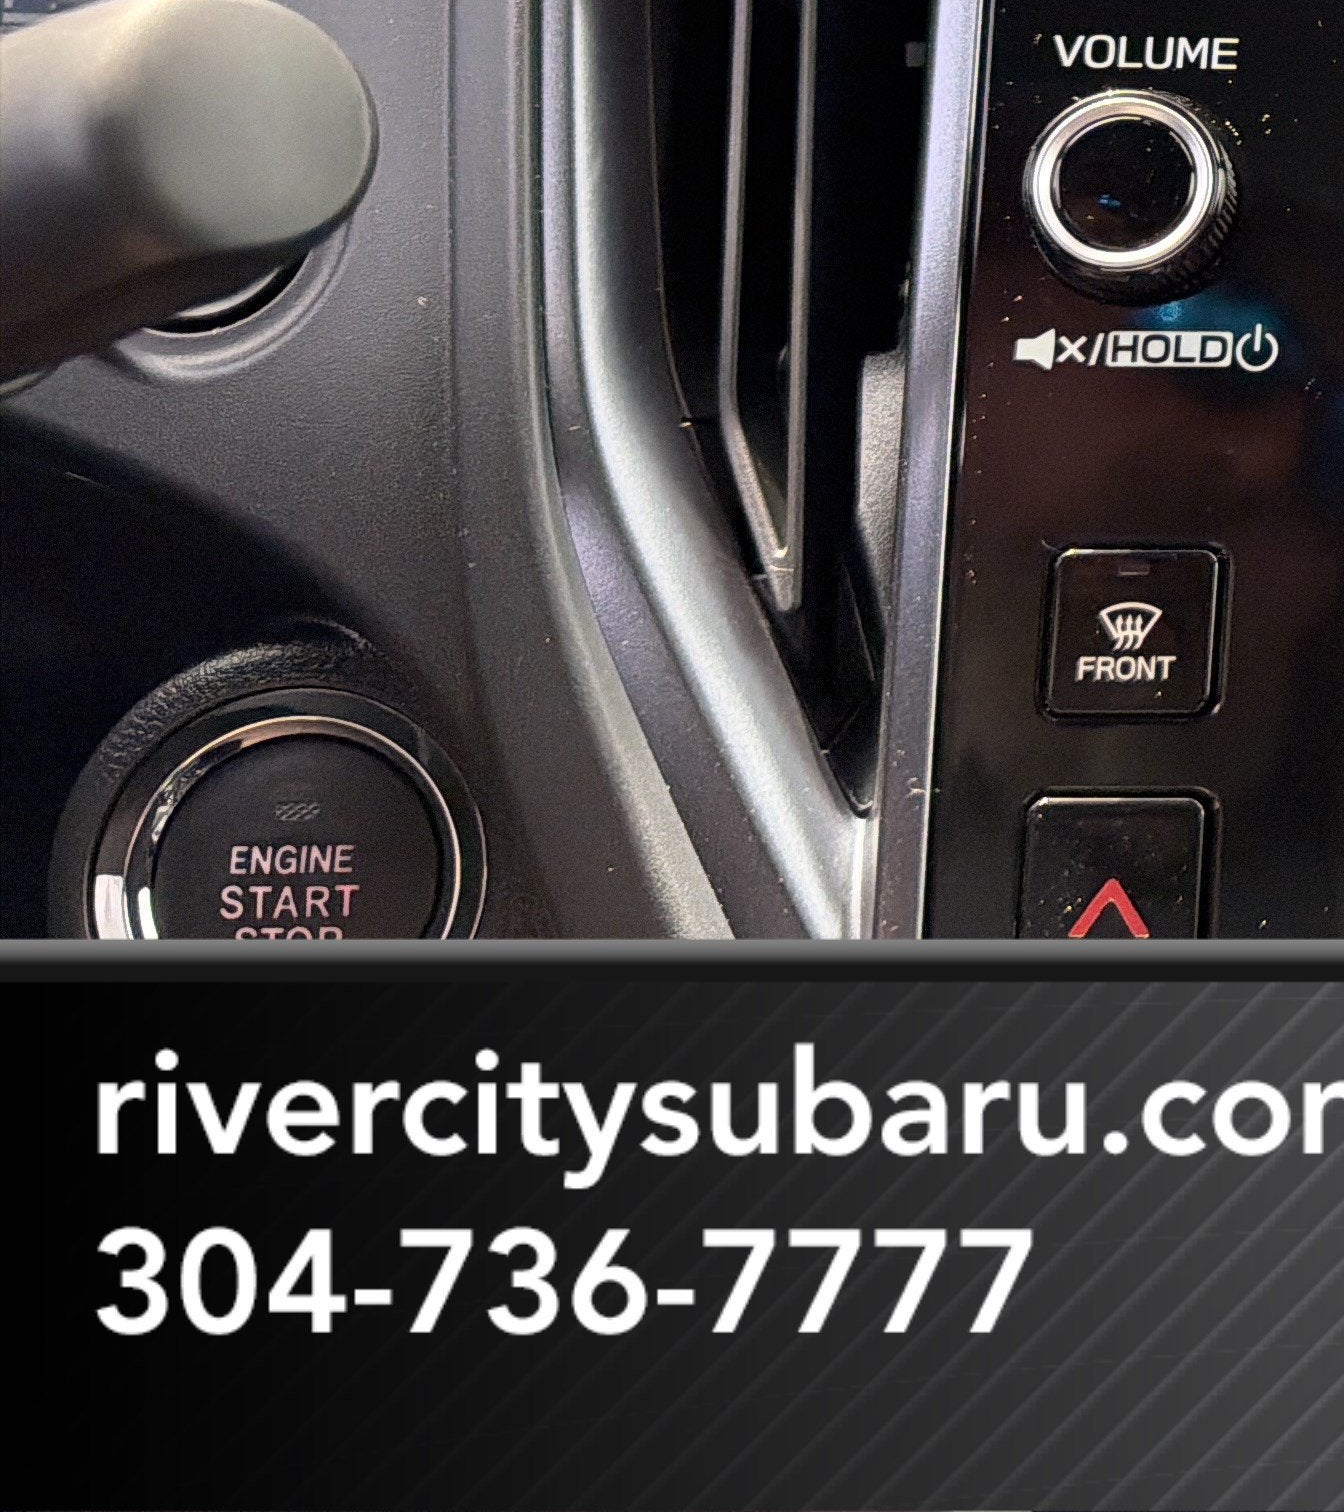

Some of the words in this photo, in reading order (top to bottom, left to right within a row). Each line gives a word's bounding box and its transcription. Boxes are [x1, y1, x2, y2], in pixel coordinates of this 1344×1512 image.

[1053, 34, 1240, 70] VOLUME
[1075, 655, 1177, 682] FRONT
[229, 844, 355, 875] ENGINE
[219, 884, 360, 920] START
